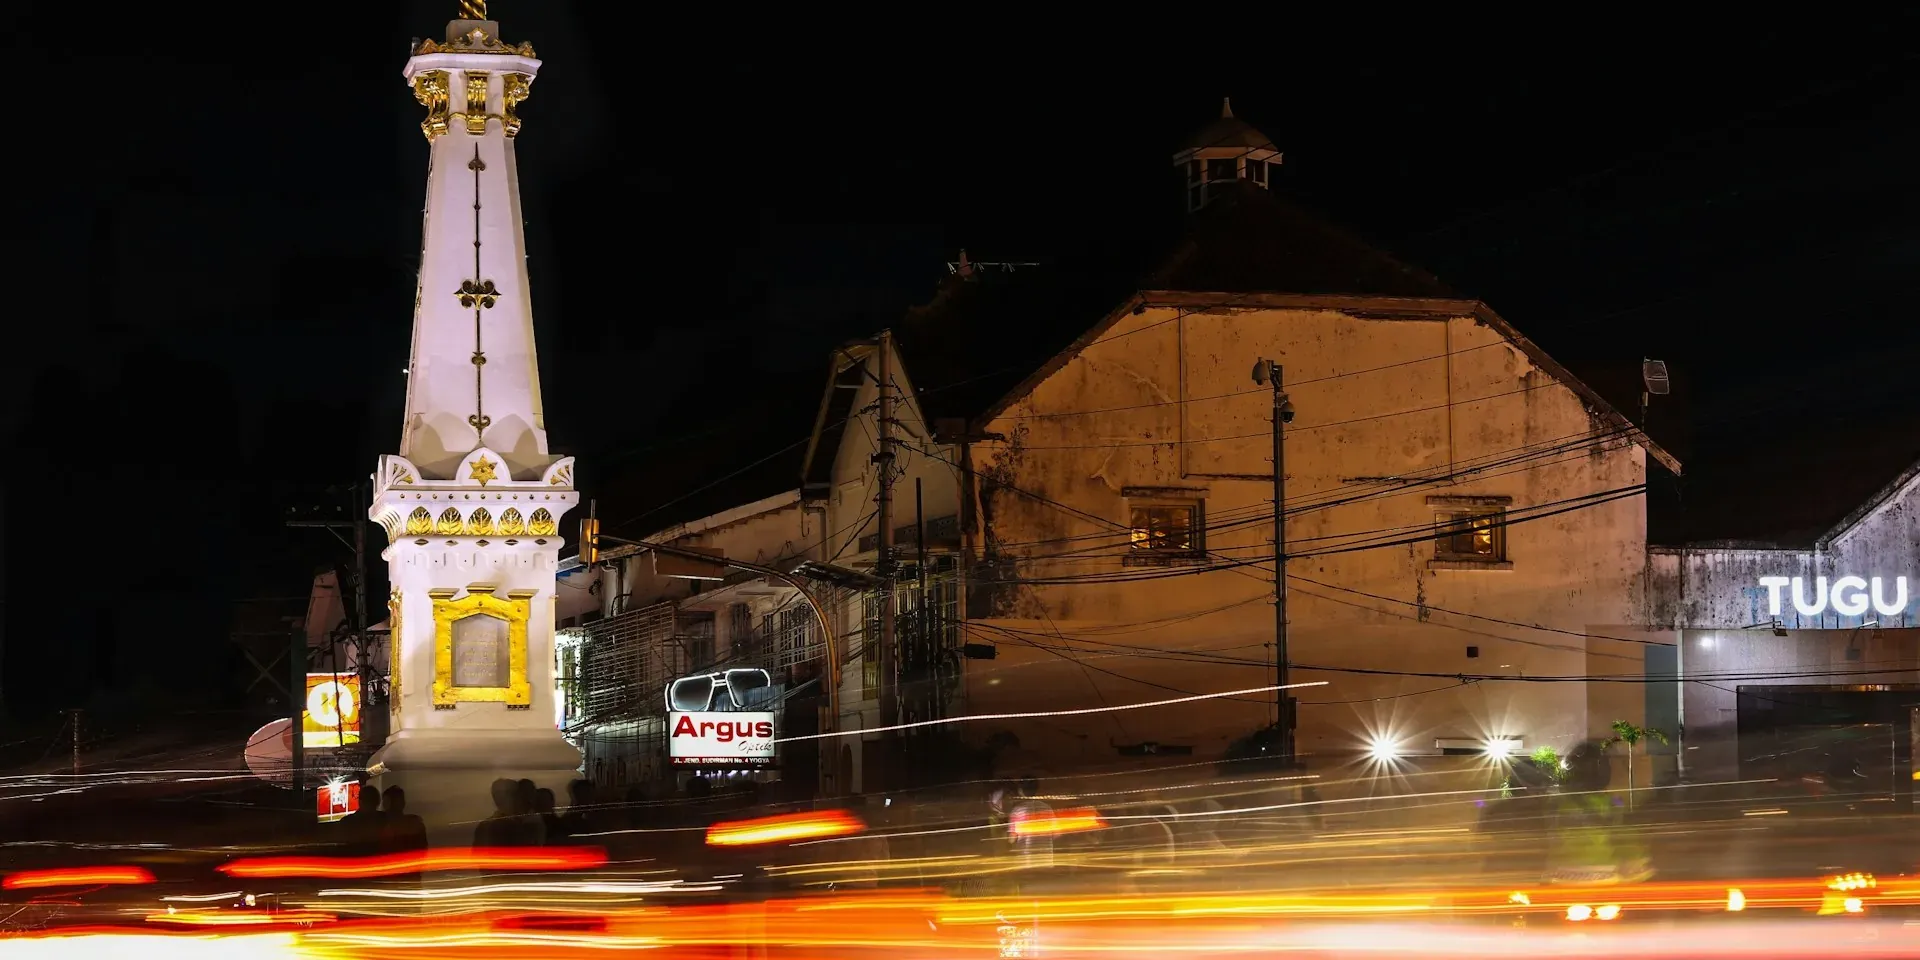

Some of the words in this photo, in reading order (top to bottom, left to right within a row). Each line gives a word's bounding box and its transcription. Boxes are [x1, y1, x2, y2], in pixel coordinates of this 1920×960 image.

[1759, 576, 1908, 616] TUGU
[672, 715, 773, 742] Argus
[738, 740, 772, 754] Optik
